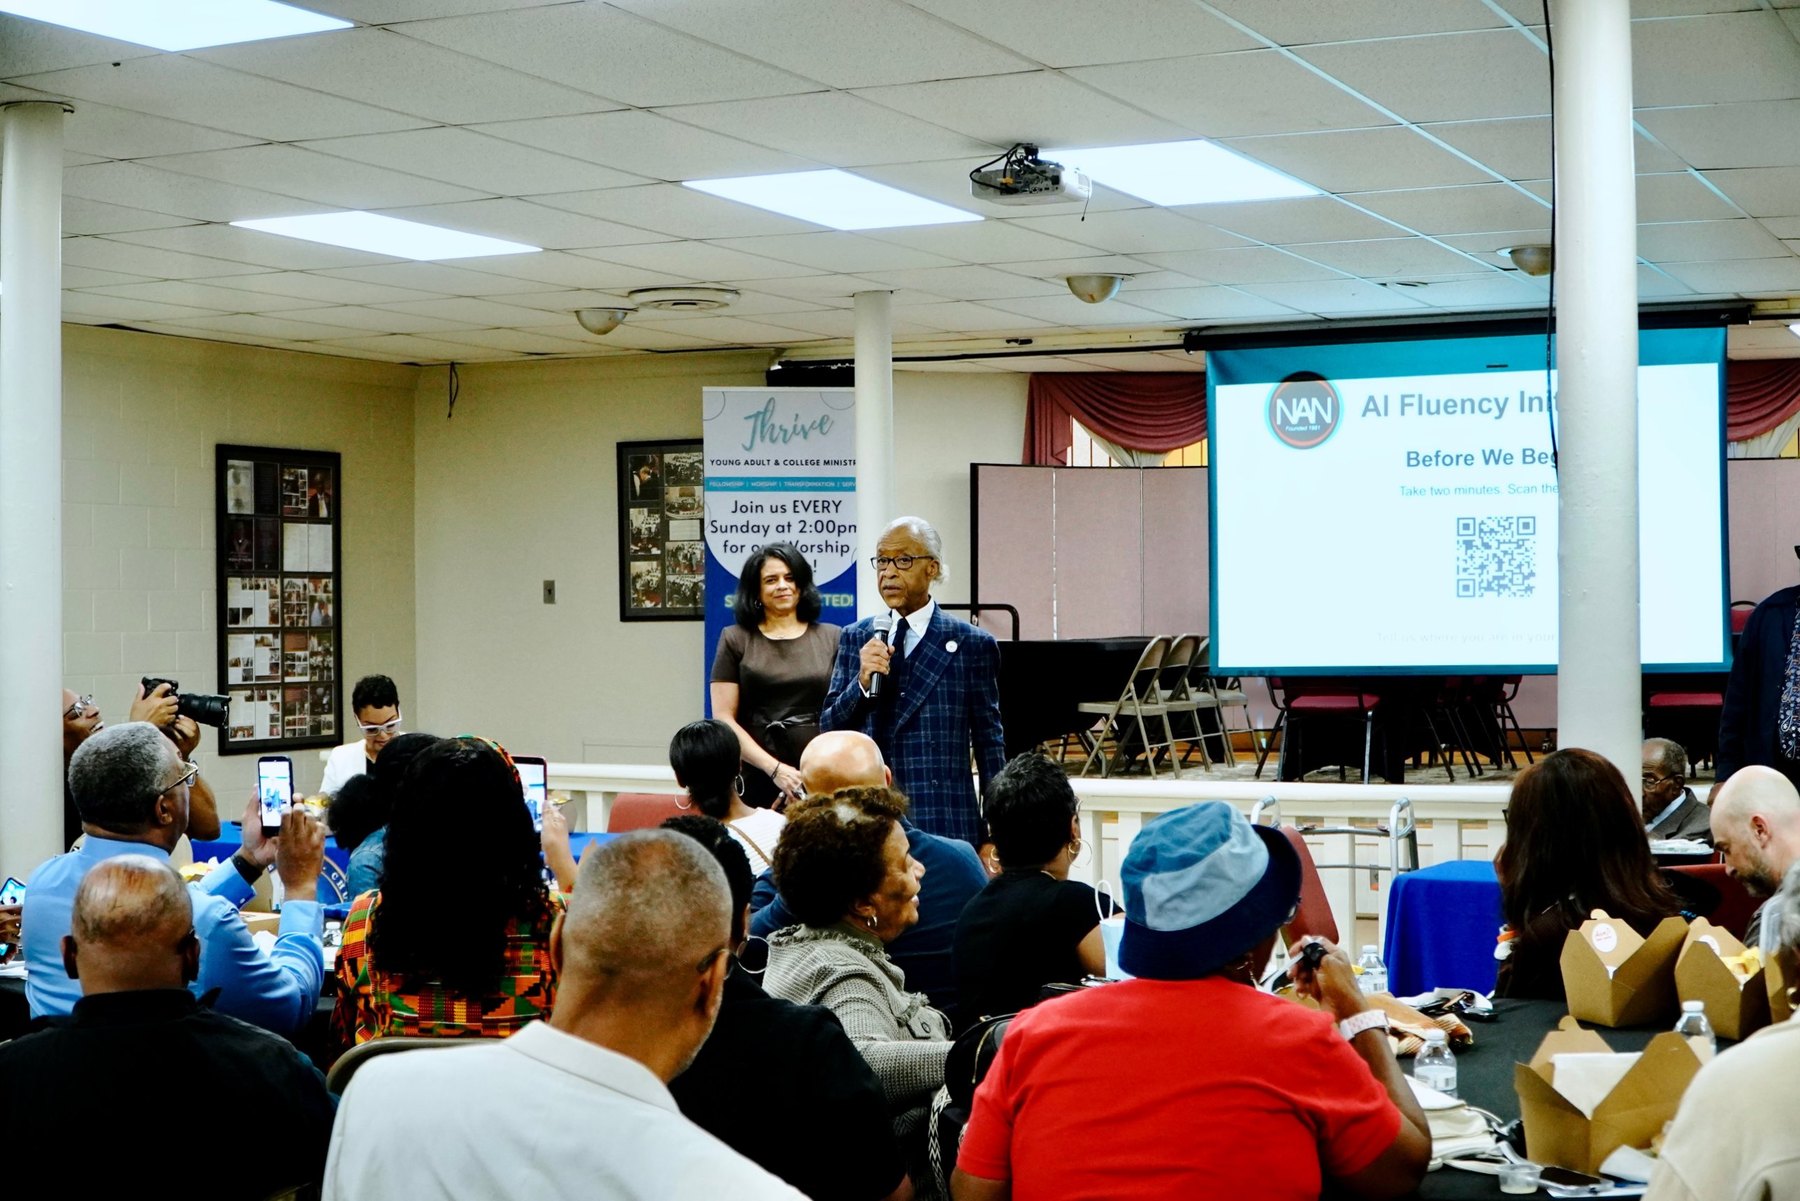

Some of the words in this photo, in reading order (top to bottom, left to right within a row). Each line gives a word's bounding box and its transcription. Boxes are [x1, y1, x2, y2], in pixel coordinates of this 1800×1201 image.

[1276, 396, 1332, 425] NAN
[1361, 394, 1389, 417] AI
[1400, 393, 1509, 420] Fluency
[741, 397, 834, 451] Thrive
[1406, 449, 1475, 468] Before
[1481, 448, 1514, 466] We
[1400, 485, 1427, 497] Take
[1430, 485, 1451, 496] two
[1507, 483, 1538, 495] Scan
[731, 500, 764, 514] Join
[770, 503, 787, 514] us
[793, 500, 842, 514] EVERY
[710, 519, 770, 537] Sunday
[775, 521, 792, 534] at
[723, 540, 745, 553] for
